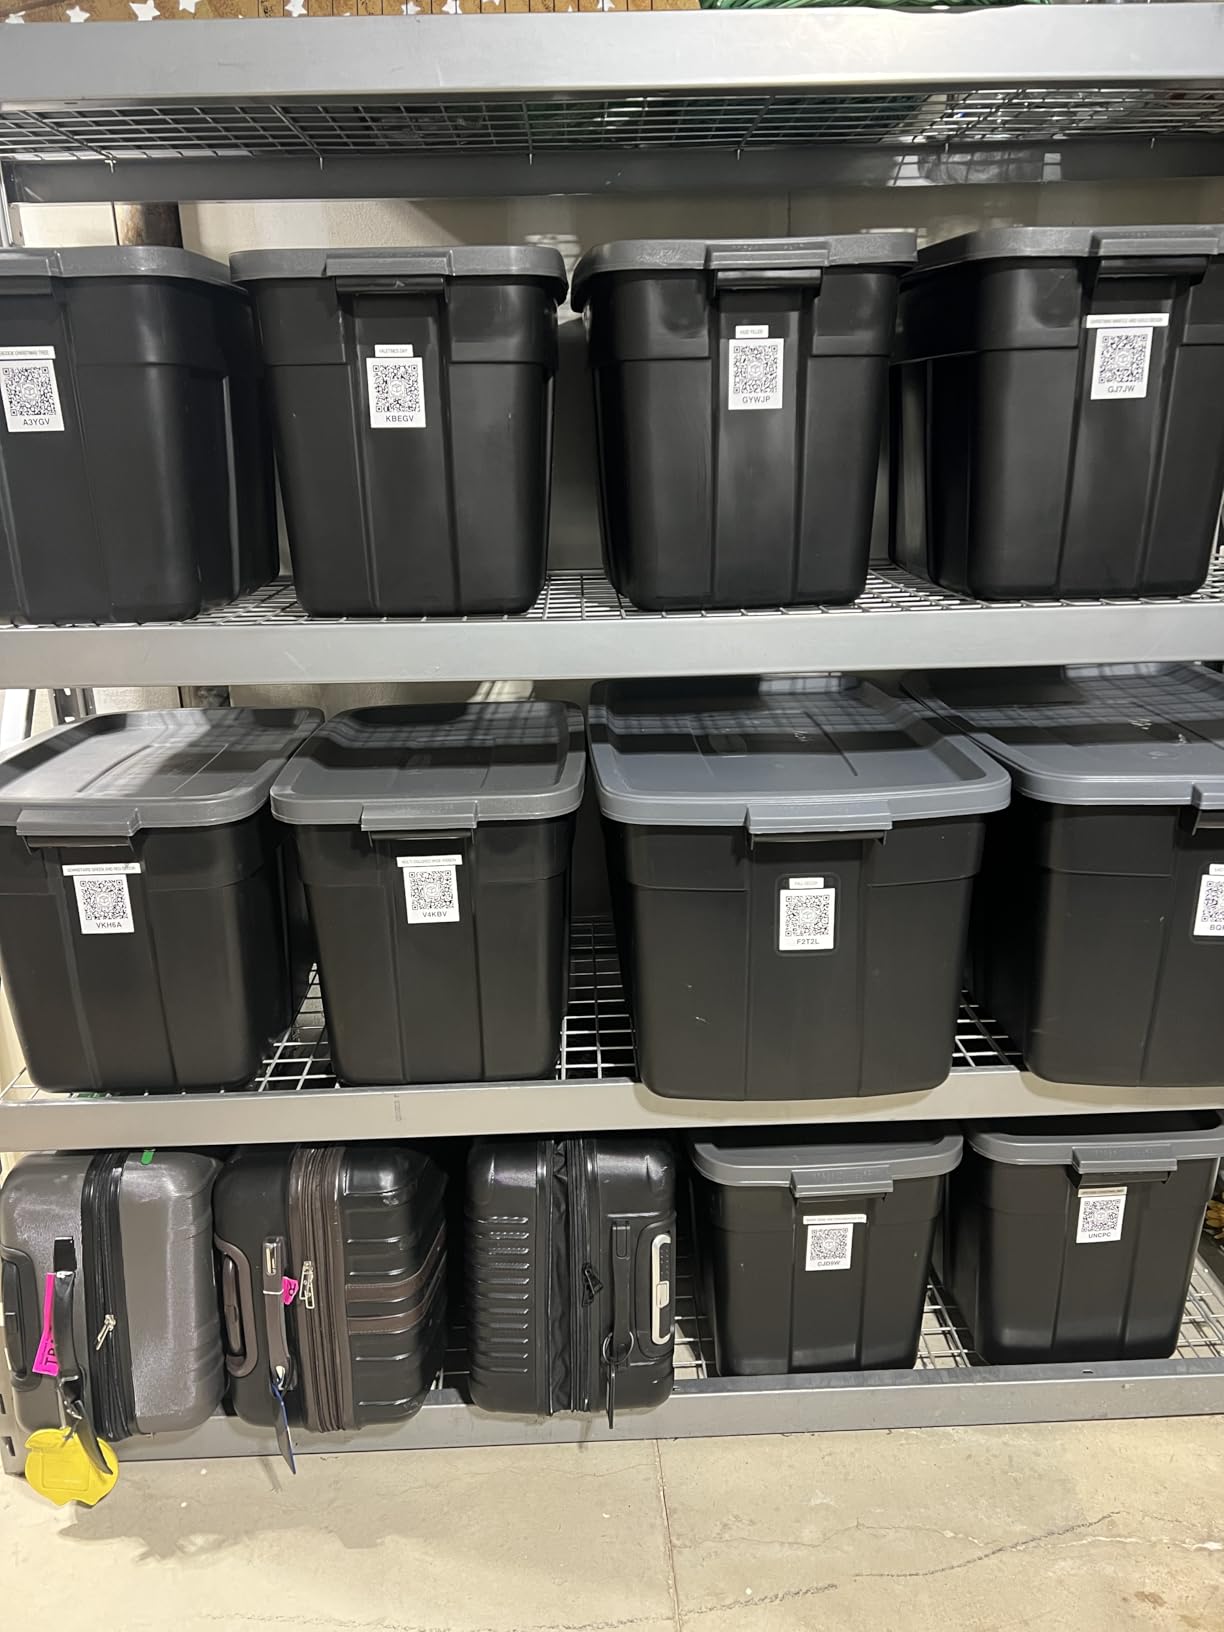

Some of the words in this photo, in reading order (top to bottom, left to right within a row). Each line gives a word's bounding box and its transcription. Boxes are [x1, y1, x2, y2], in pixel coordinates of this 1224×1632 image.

[742, 395, 771, 404] GYWJP
[23, 418, 50, 426] A3YGV
[385, 415, 414, 423] KBEGV
